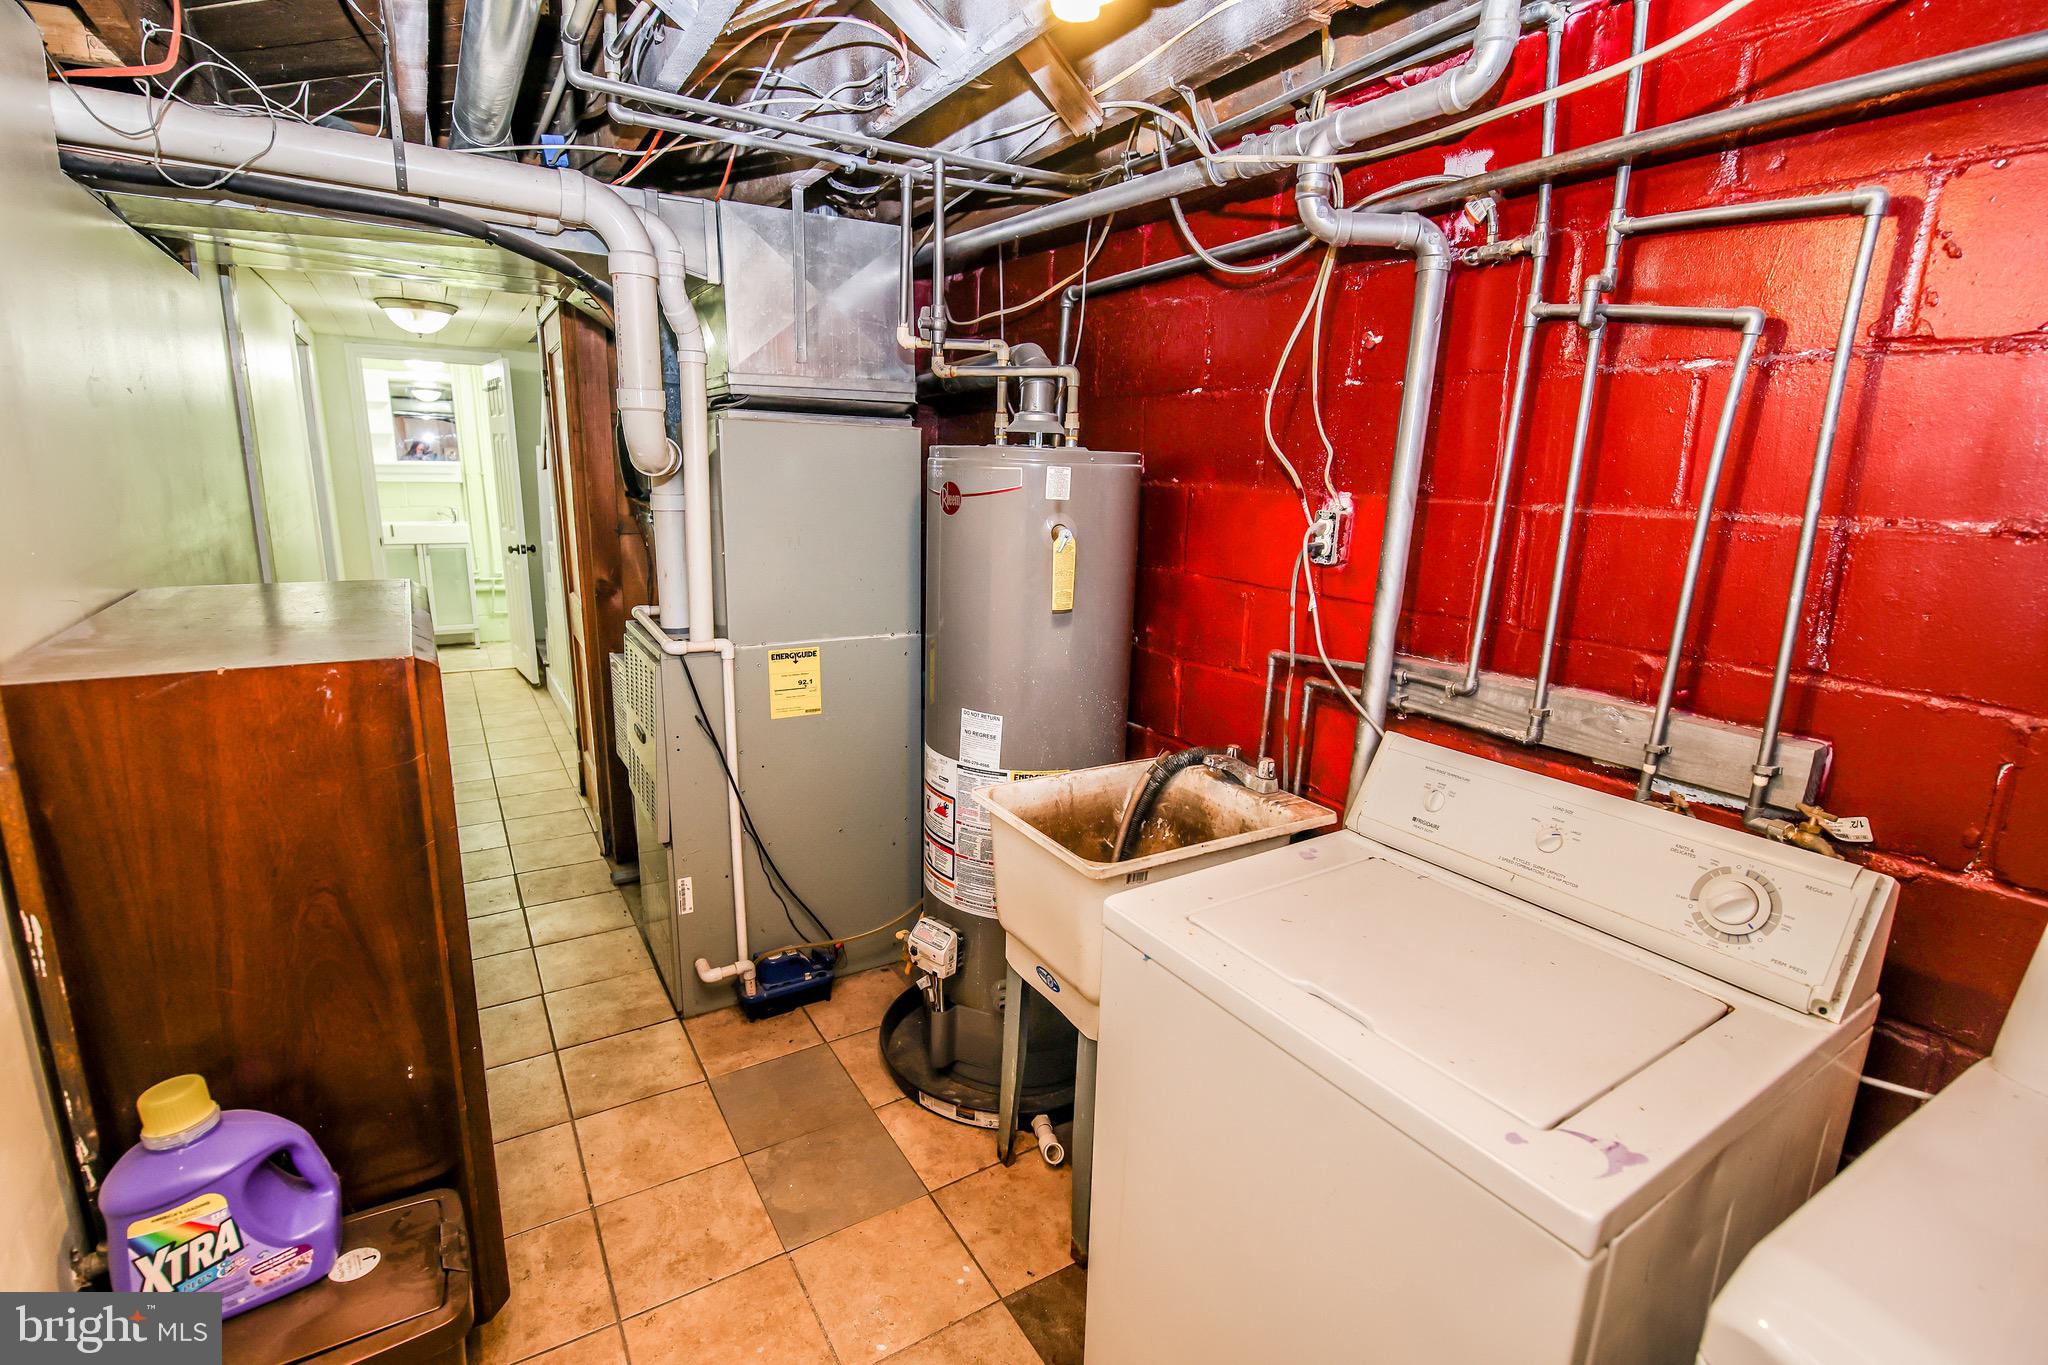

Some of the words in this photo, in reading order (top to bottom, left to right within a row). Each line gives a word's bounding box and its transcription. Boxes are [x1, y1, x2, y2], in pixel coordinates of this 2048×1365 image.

[941, 482, 961, 510] Rheem
[771, 650, 818, 662] ENERGYGUIDE
[797, 678, 813, 686] 92.1
[981, 714, 1001, 722] RETURN
[972, 731, 997, 740] REGRESE
[1670, 847, 1696, 859] DELICATES
[1805, 884, 1833, 897] REGULAR
[1788, 964, 1808, 976] PRESS
[133, 1217, 243, 1293] XTRA
